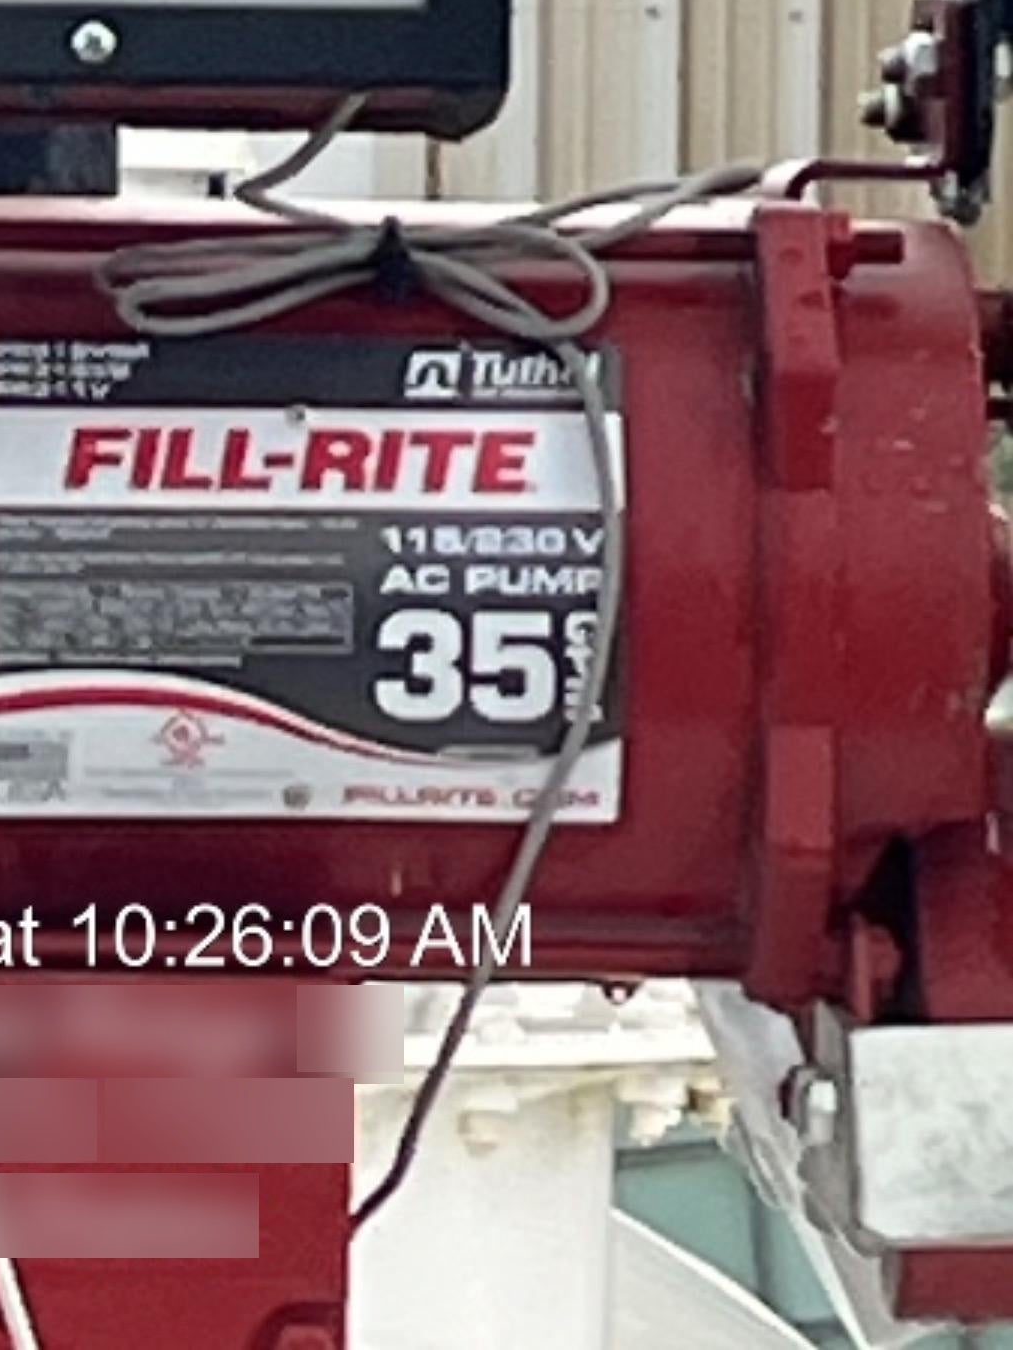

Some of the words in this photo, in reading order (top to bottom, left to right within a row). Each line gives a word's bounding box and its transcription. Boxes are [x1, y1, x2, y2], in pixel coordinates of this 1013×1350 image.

[65, 426, 536, 494] FILL-RITE
[379, 564, 451, 595] AC
[375, 607, 556, 722] 35
